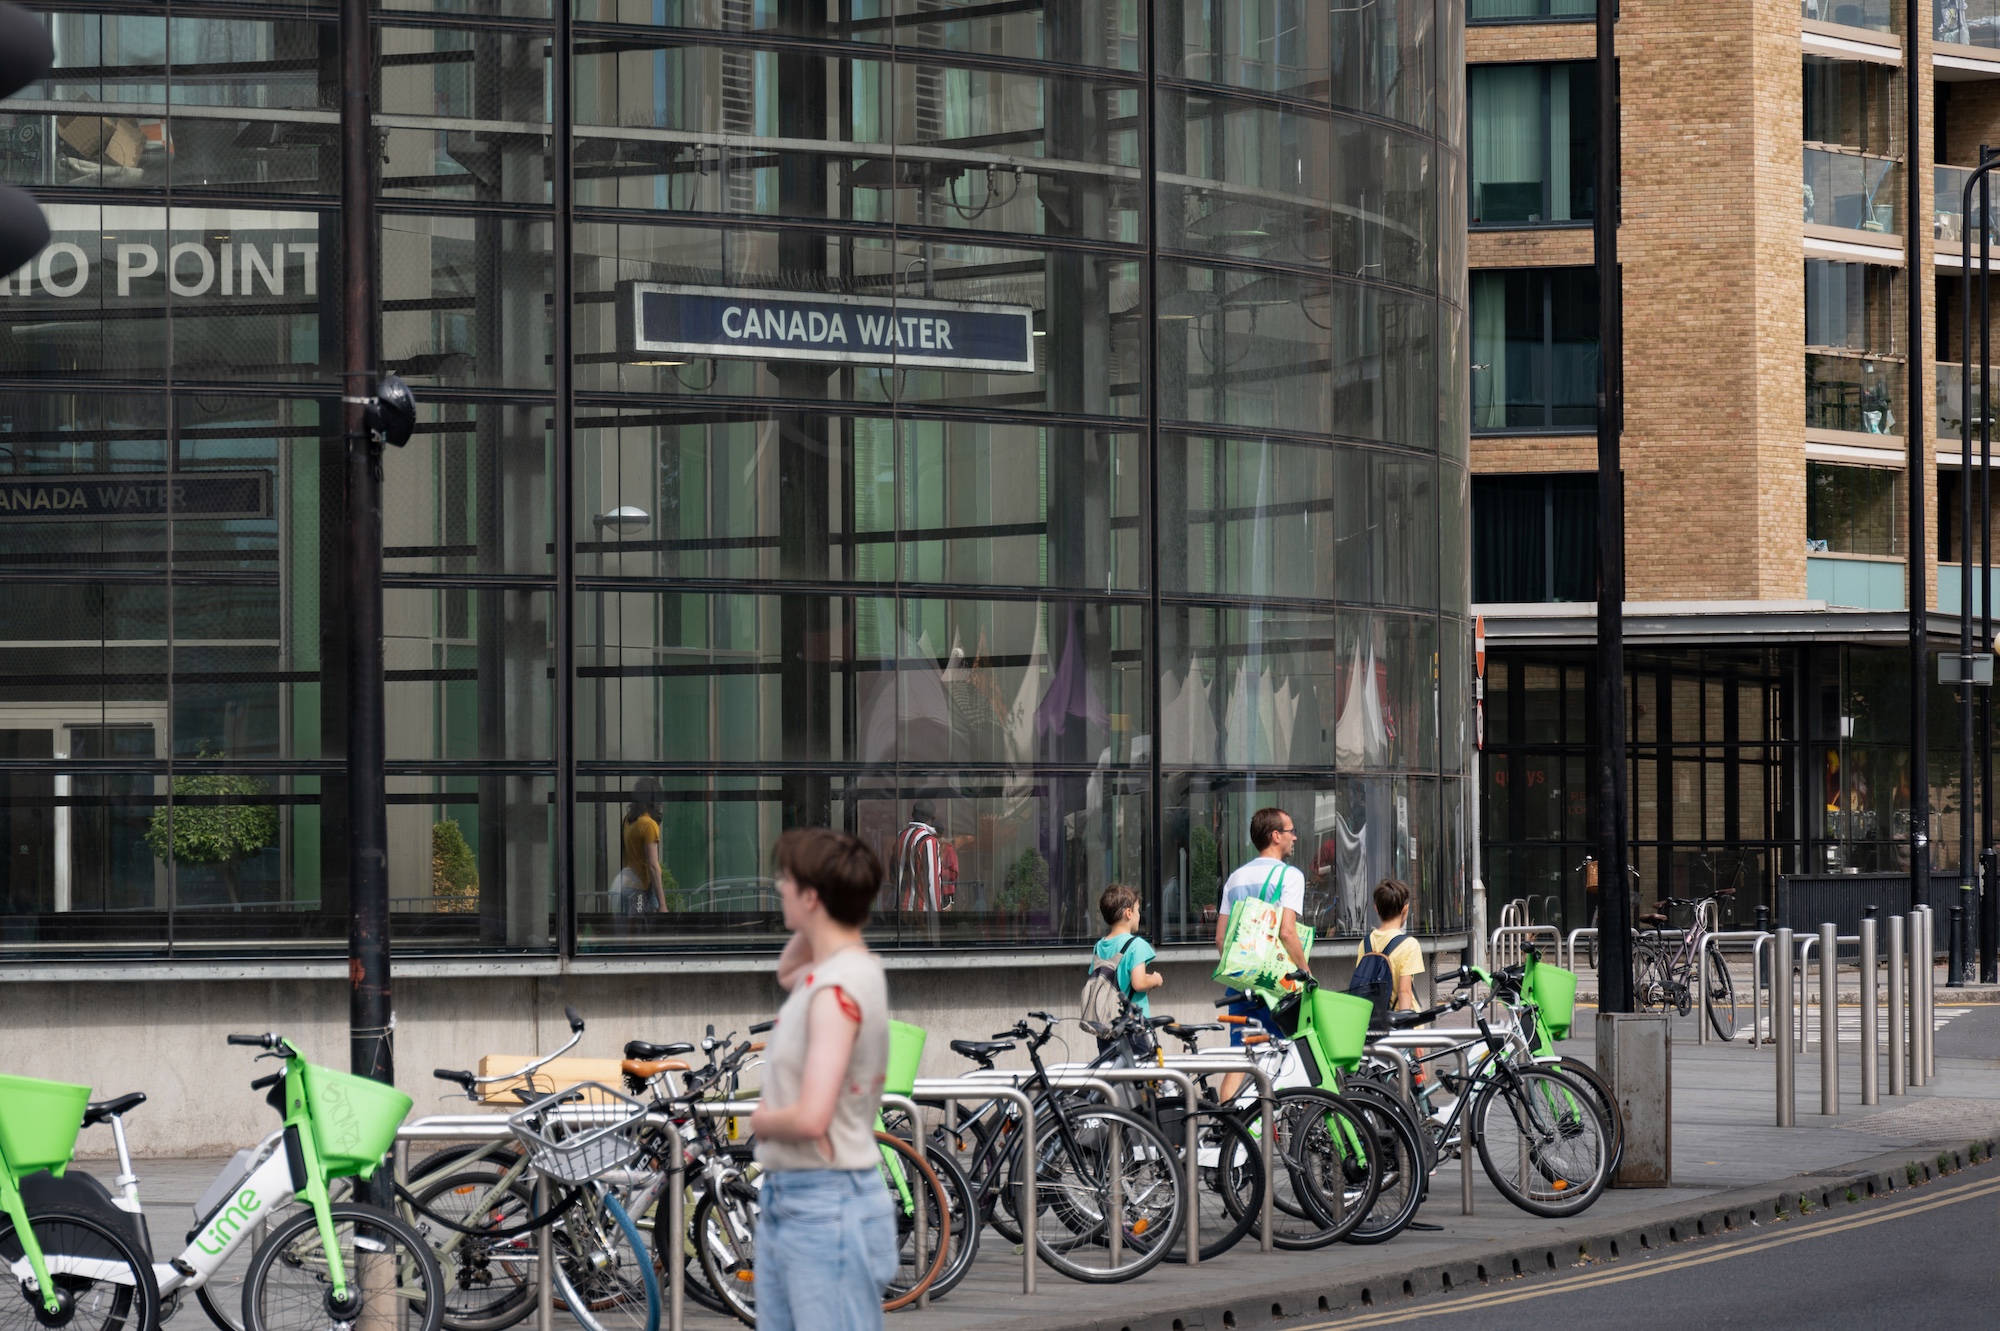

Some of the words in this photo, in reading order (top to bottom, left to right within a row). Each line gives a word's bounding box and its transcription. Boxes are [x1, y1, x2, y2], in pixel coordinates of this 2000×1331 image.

[0, 242, 89, 298] IO
[117, 242, 319, 297] POINT
[721, 306, 848, 344] CANADA
[856, 314, 954, 350] WATER
[97, 485, 188, 508] WATER
[1495, 770, 1545, 788] qys
